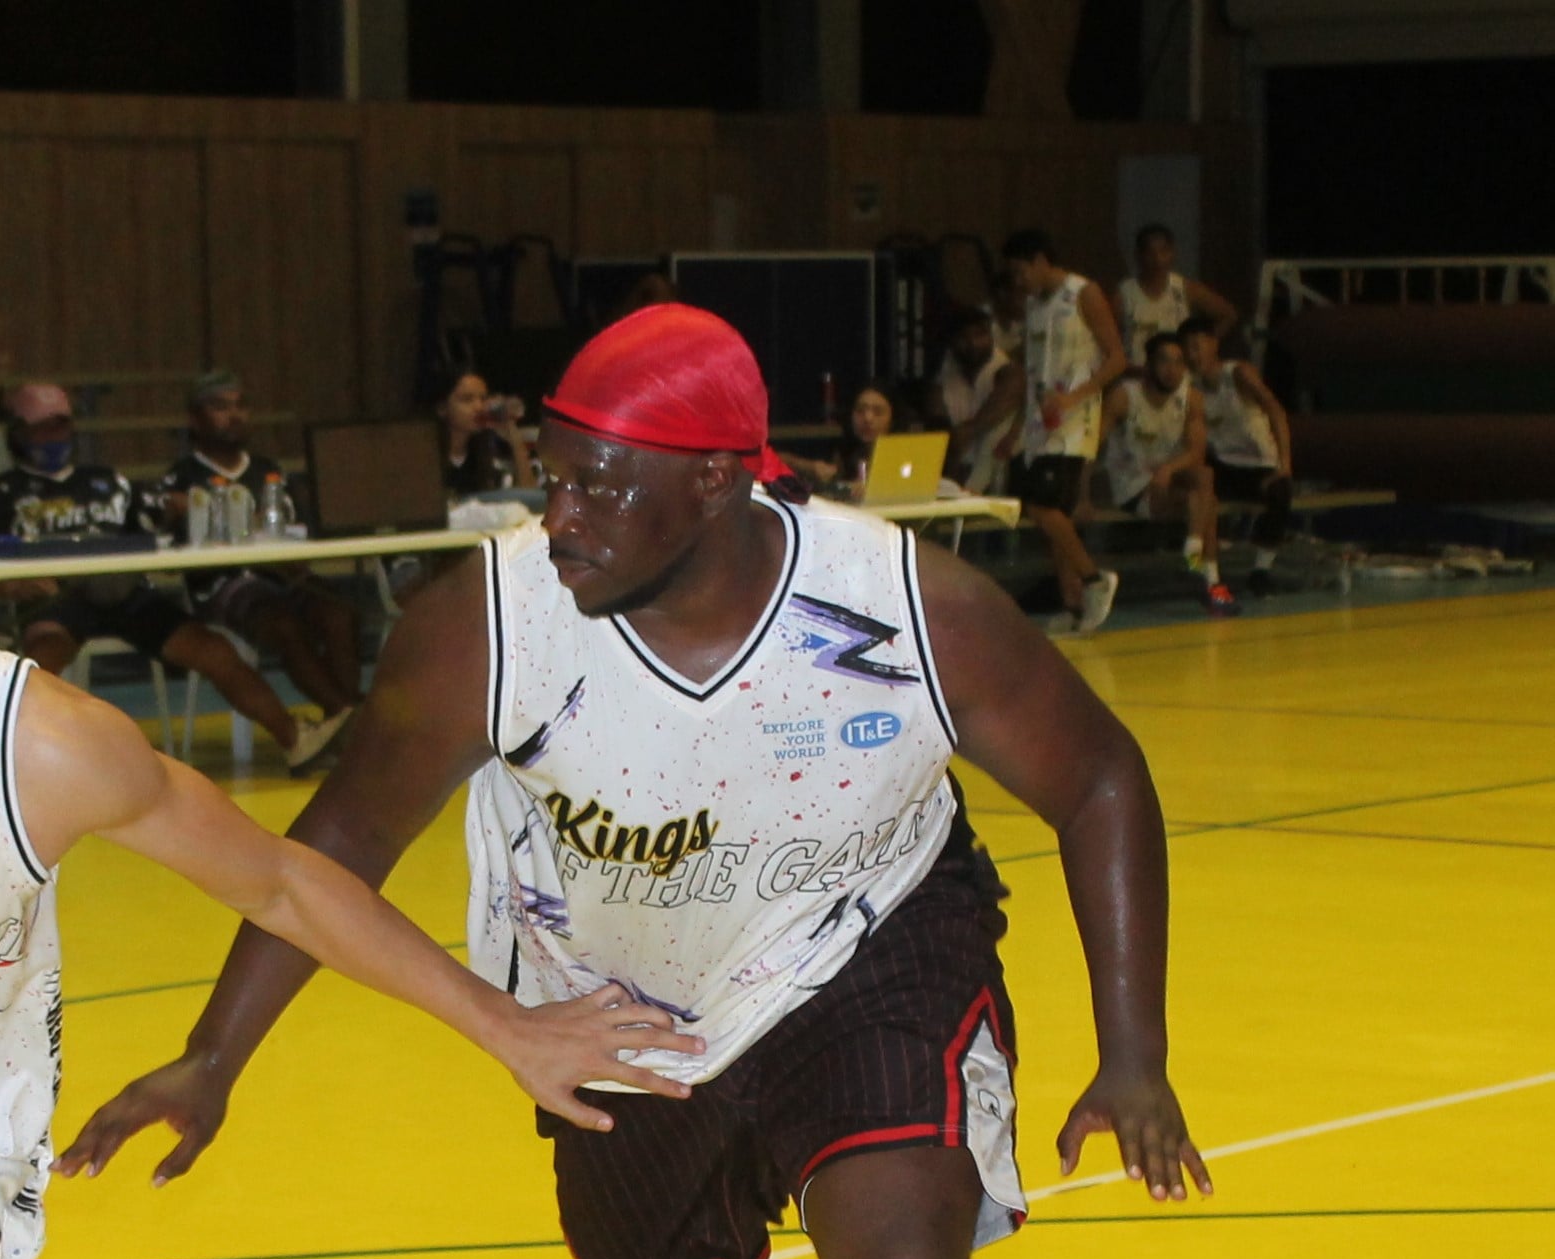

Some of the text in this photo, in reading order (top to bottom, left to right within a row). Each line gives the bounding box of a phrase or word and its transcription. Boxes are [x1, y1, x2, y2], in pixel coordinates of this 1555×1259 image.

[762, 719, 825, 735] EXPLORE
[846, 716, 895, 744] IT&E
[785, 732, 826, 746] YOUR
[773, 746, 827, 761] WORLD
[545, 791, 720, 876] Kings
[600, 842, 750, 909] THE
[756, 800, 926, 901] GAM
